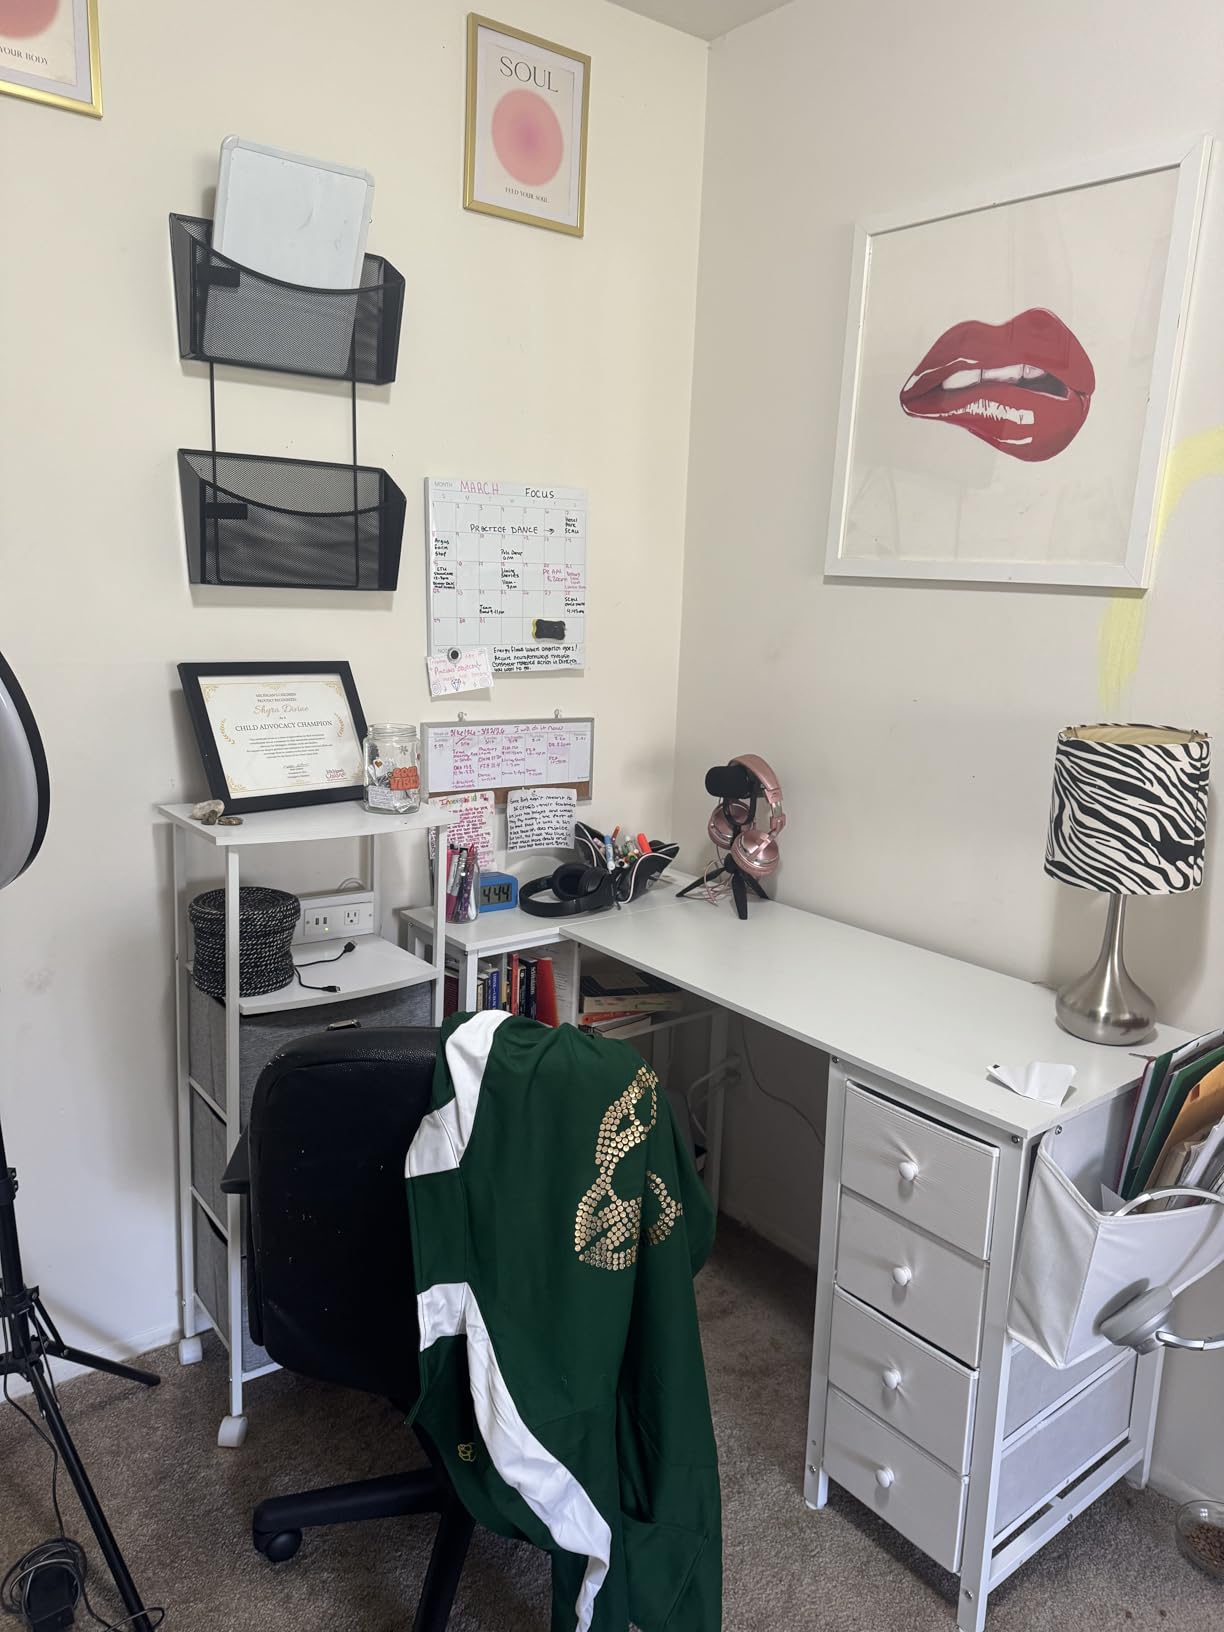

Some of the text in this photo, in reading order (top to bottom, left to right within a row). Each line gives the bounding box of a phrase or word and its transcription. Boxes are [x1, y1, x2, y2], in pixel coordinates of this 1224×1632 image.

[26, 52, 48, 64] BODY
[500, 56, 559, 93] SOUL
[505, 186, 519, 196] FEED
[520, 190, 534, 199] YOUR
[460, 480, 499, 496] MARCH
[470, 524, 506, 533] PRACTICE
[260, 722, 296, 730] ADVOCACY
